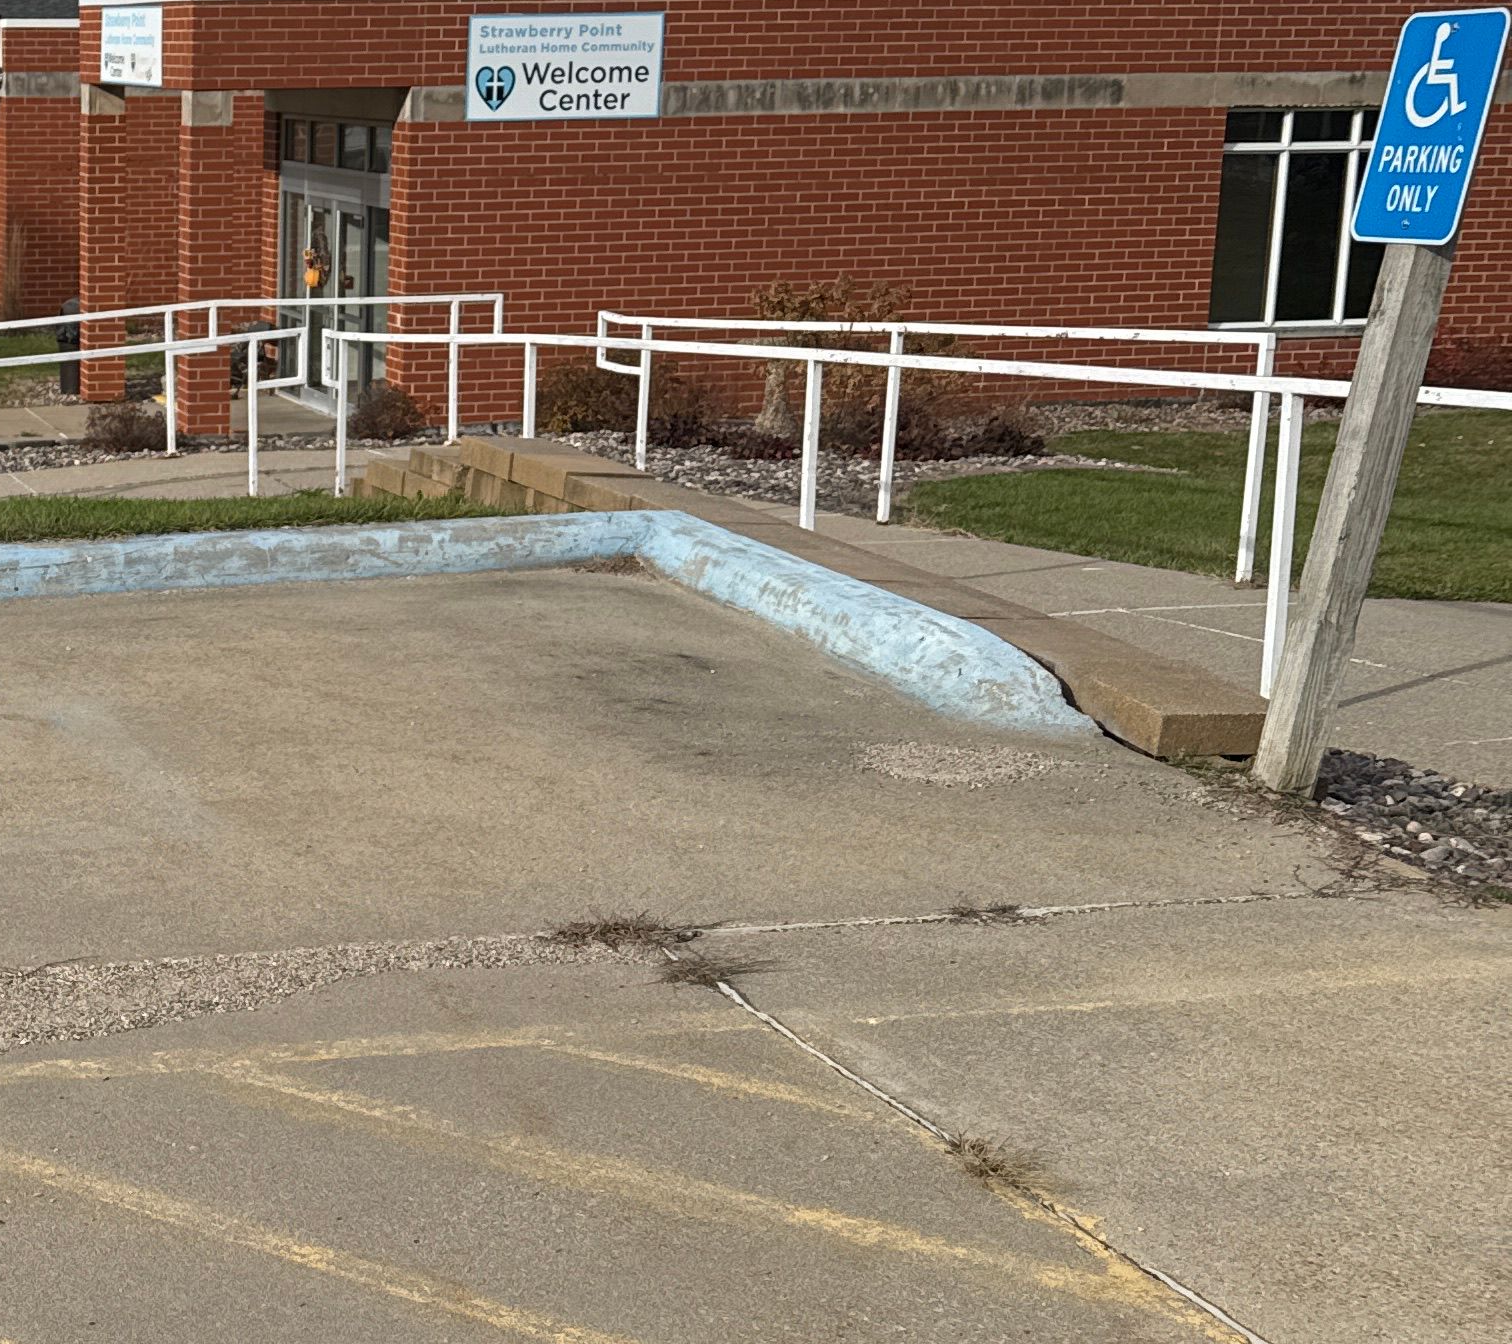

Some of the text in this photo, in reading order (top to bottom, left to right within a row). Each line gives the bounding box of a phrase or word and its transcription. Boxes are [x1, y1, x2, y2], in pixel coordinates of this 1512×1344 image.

[480, 23, 622, 39] Strawberry Point
[479, 40, 655, 54] Lutheran Home Community
[522, 61, 650, 84] Welcome
[540, 89, 630, 111] Center
[1378, 144, 1465, 174] PARKING
[1386, 184, 1439, 213] ONLY
